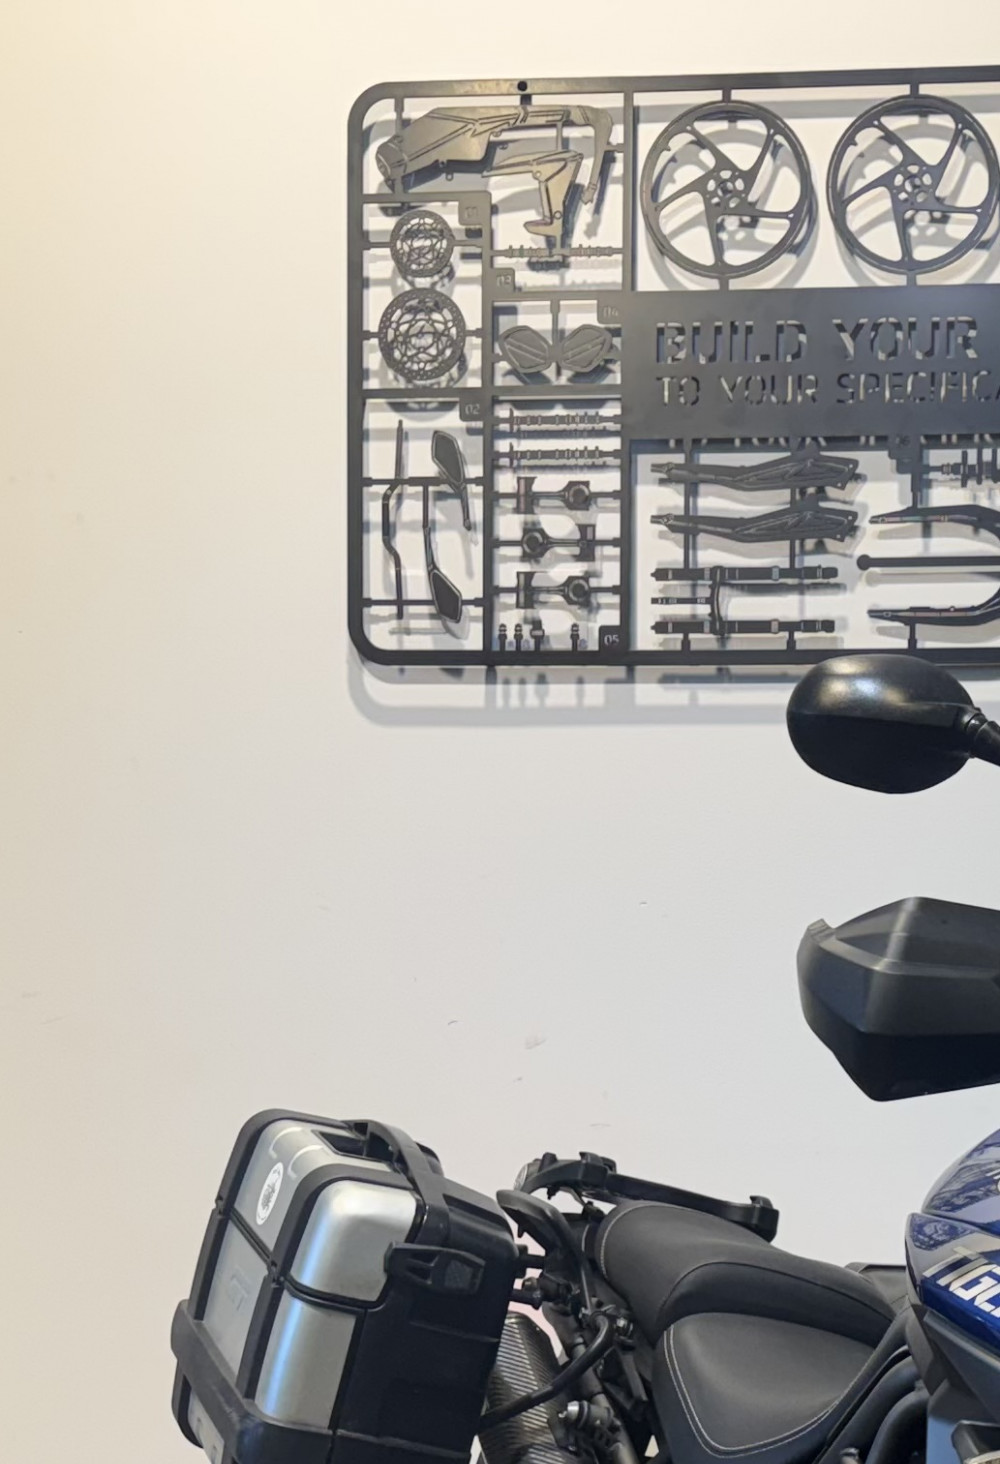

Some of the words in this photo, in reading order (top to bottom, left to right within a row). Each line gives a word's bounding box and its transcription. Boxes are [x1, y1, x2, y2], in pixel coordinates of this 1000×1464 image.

[656, 319, 807, 364] BUILD
[832, 315, 979, 361] YOUR
[656, 376, 700, 406] TO
[720, 374, 819, 406] YOUR
